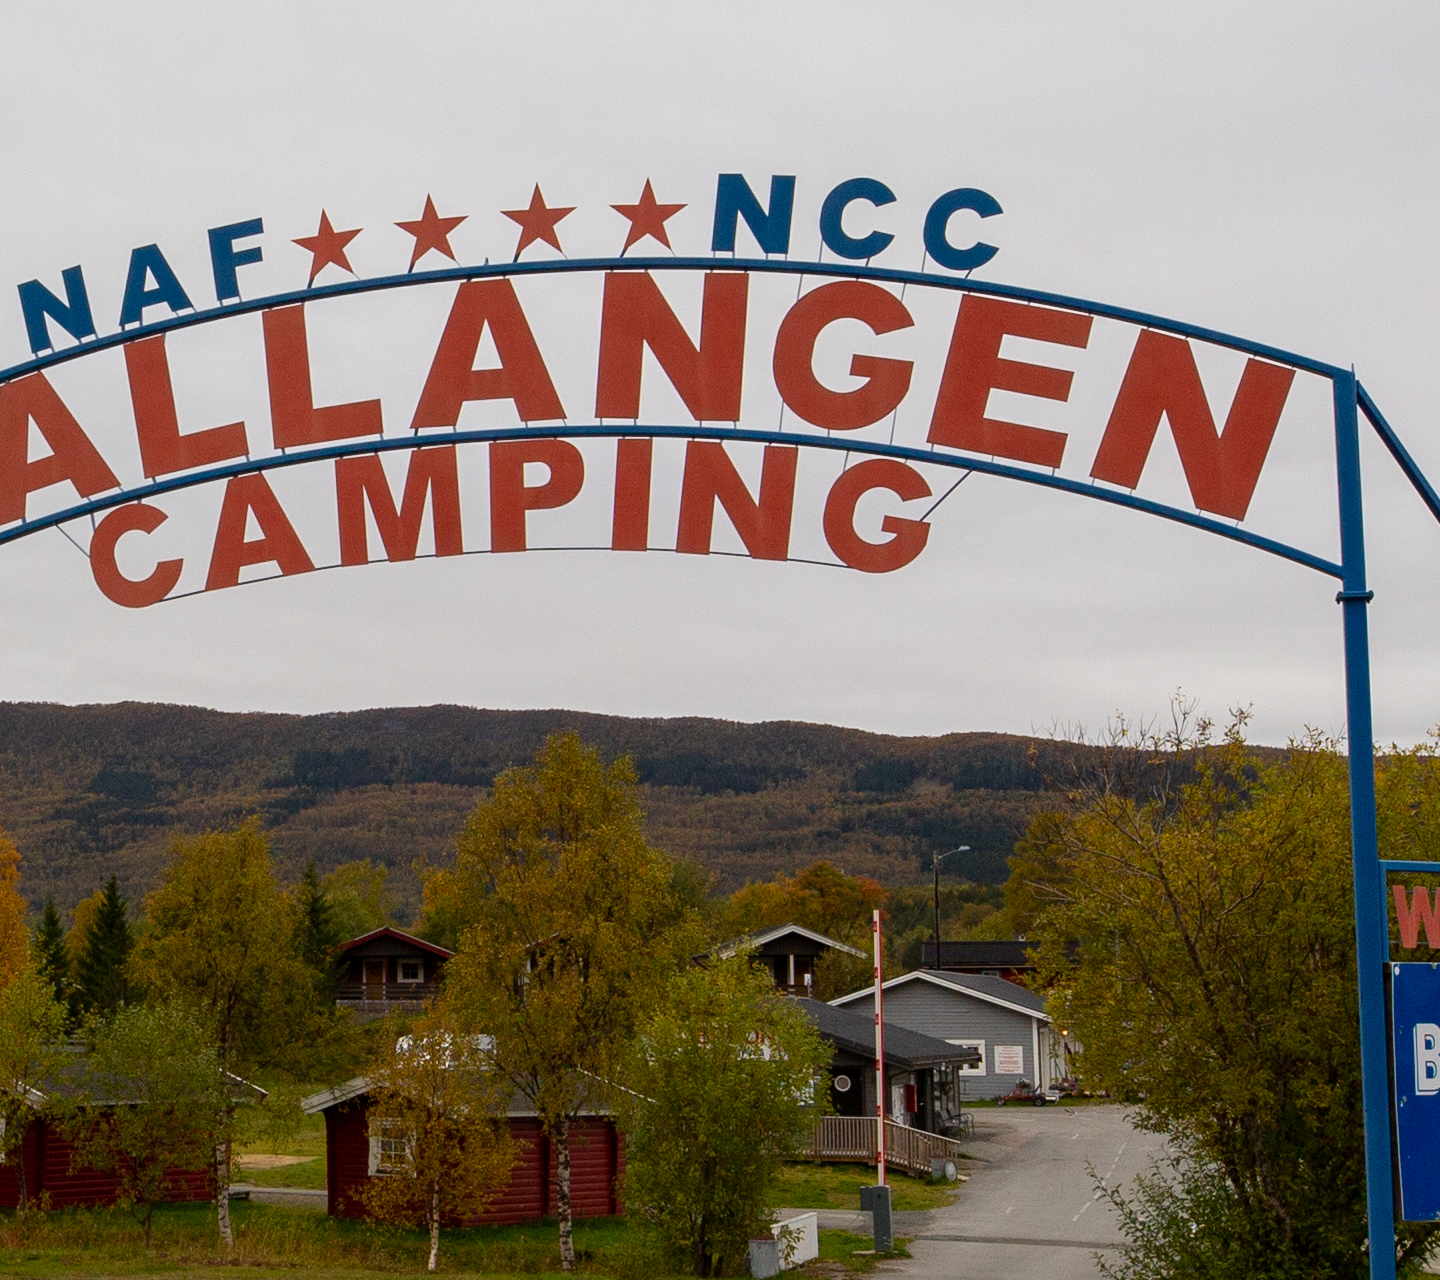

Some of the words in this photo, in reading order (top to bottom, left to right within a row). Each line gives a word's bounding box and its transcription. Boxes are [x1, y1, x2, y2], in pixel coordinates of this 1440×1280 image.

[17, 218, 266, 355] NAF
[710, 173, 1005, 271] NCC
[89, 439, 932, 609] CAMPING
